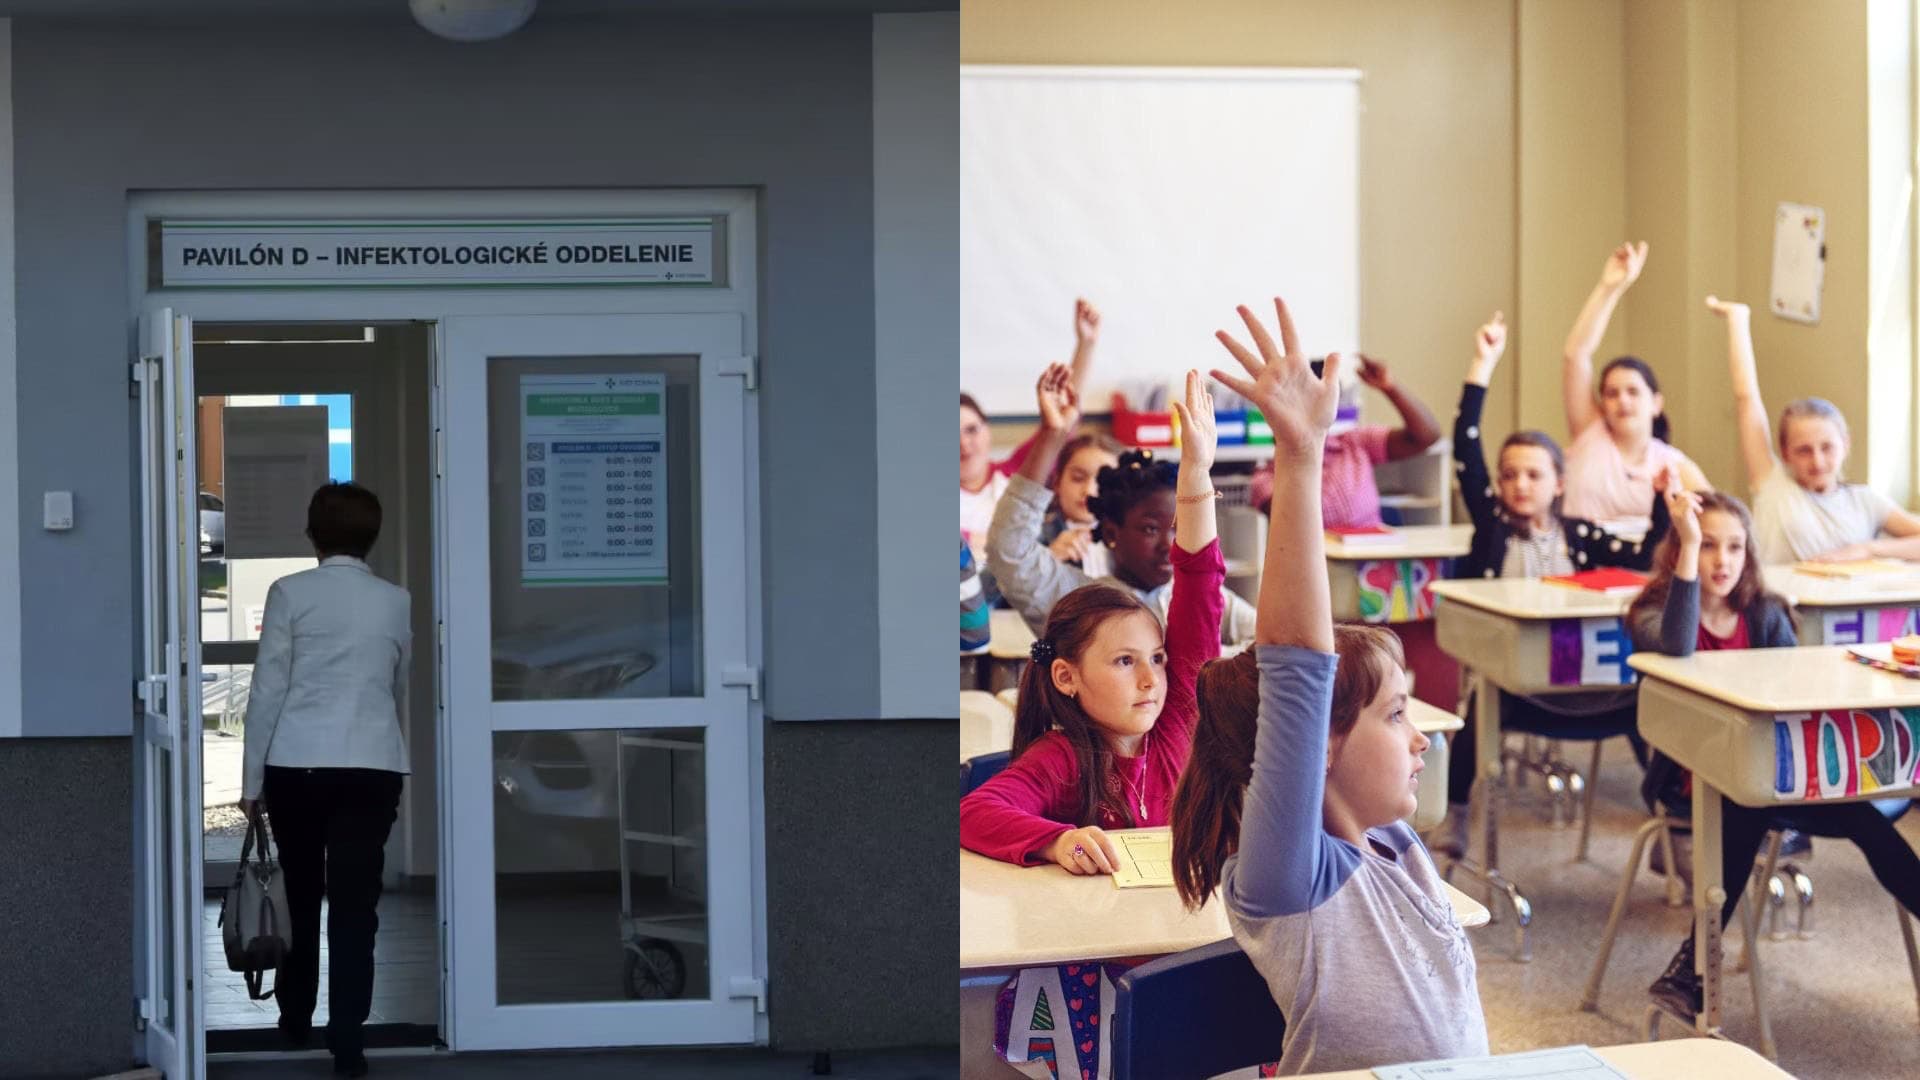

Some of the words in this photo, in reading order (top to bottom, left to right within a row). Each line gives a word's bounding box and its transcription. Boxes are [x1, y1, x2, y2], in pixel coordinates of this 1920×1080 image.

[182, 243, 284, 266] PAVILÓN
[292, 247, 309, 265] D
[336, 241, 548, 265] INFEKTOLOGICKÉ
[555, 244, 694, 264] ODDELENIE
[1358, 560, 1440, 624] SAR
[1774, 708, 1920, 800] JORD
